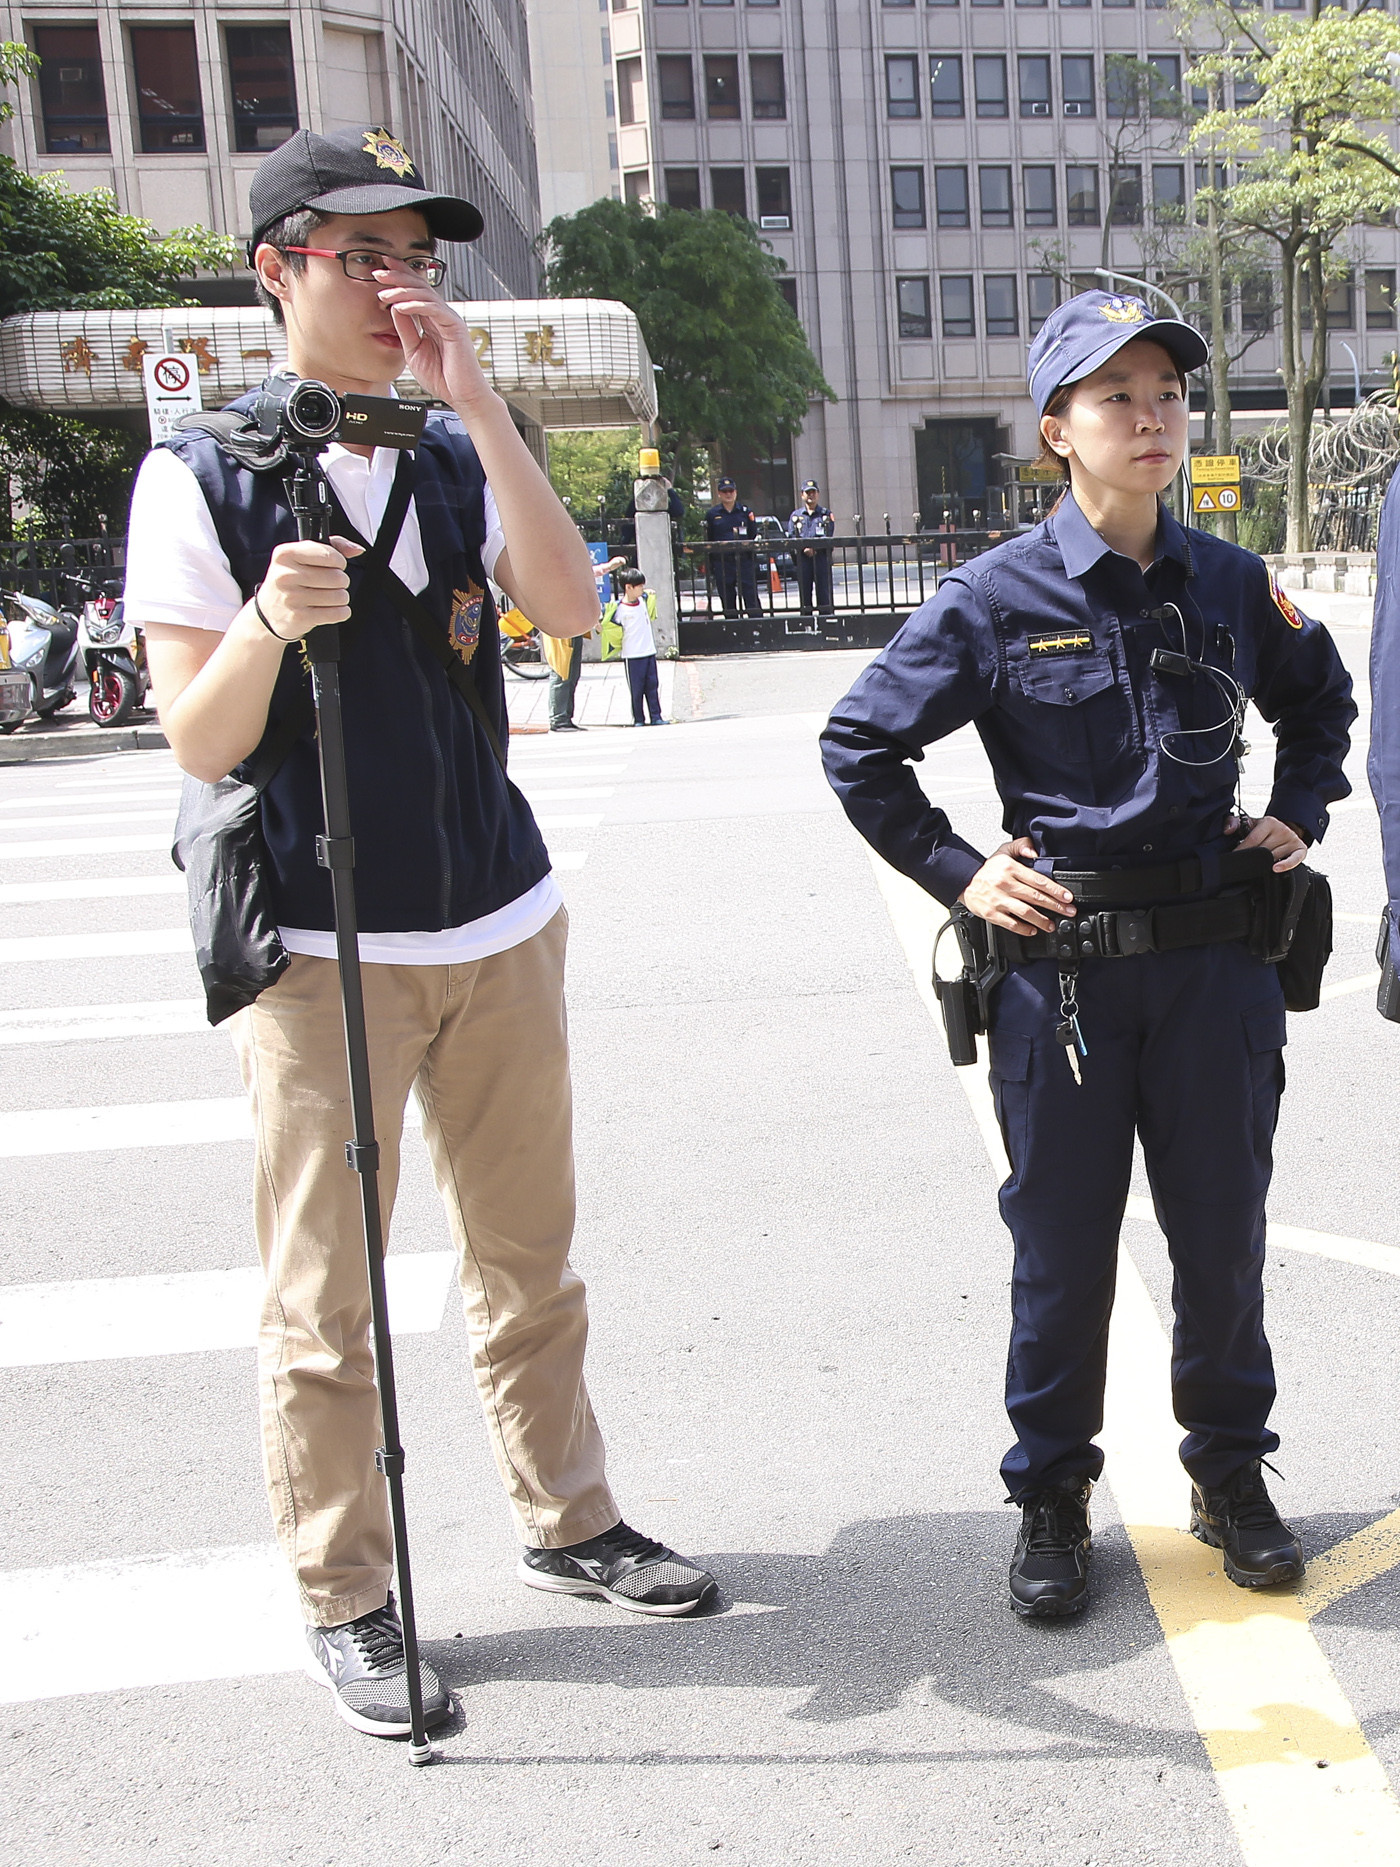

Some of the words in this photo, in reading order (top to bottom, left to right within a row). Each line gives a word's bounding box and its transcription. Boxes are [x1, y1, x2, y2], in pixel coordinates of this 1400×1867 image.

[398, 404, 422, 412] SONY
[345, 412, 368, 421] HD
[1222, 494, 1233, 503] 10
